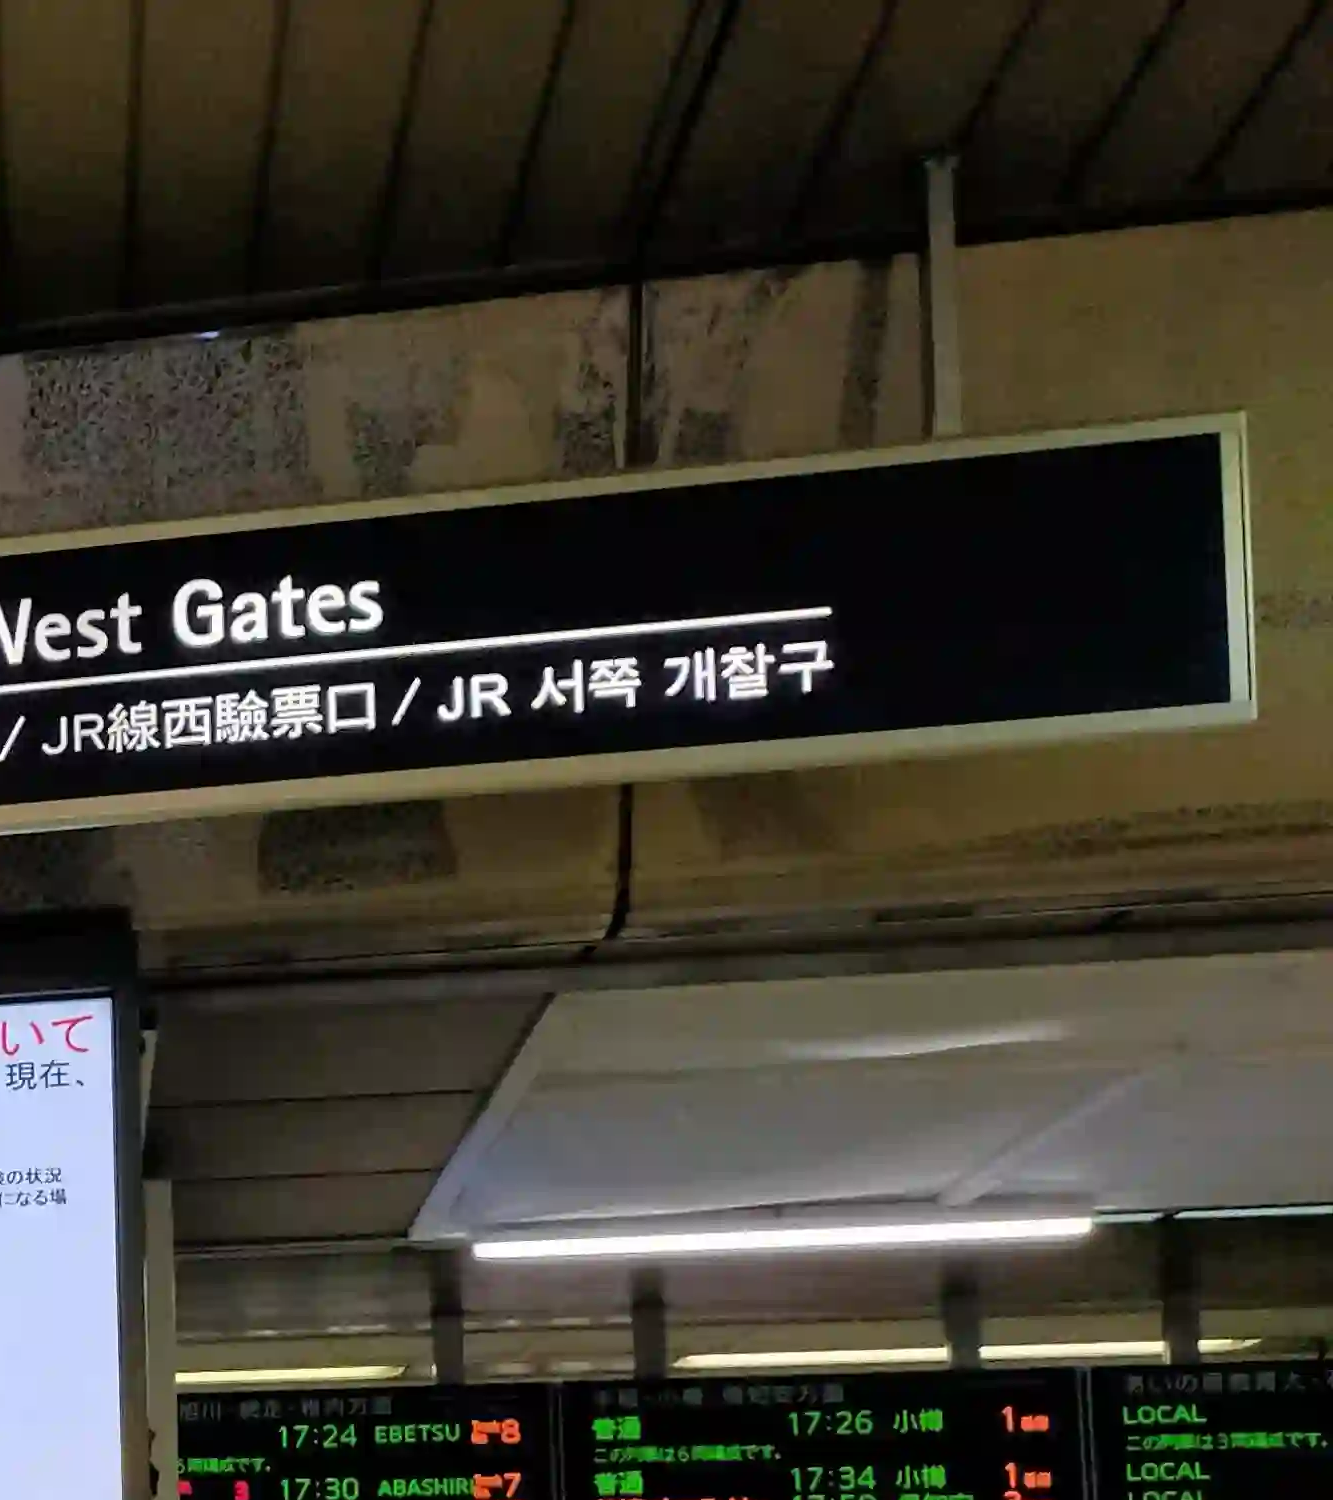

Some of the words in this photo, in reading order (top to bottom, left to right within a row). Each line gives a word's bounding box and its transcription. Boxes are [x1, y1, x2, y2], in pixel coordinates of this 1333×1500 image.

[172, 574, 385, 650] Gates
[42, 684, 377, 758] JR線西驗票口
[438, 673, 509, 720] JR
[530, 660, 642, 716] 서쪽
[664, 638, 837, 703] 개찰구
[788, 1409, 873, 1437] 17:26
[1122, 1403, 1208, 1426] LOCAL
[278, 1423, 357, 1450] 17:24
[374, 1422, 461, 1445] EBETSU
[791, 1465, 877, 1492] 17:34
[1125, 1461, 1213, 1483] LOCAL
